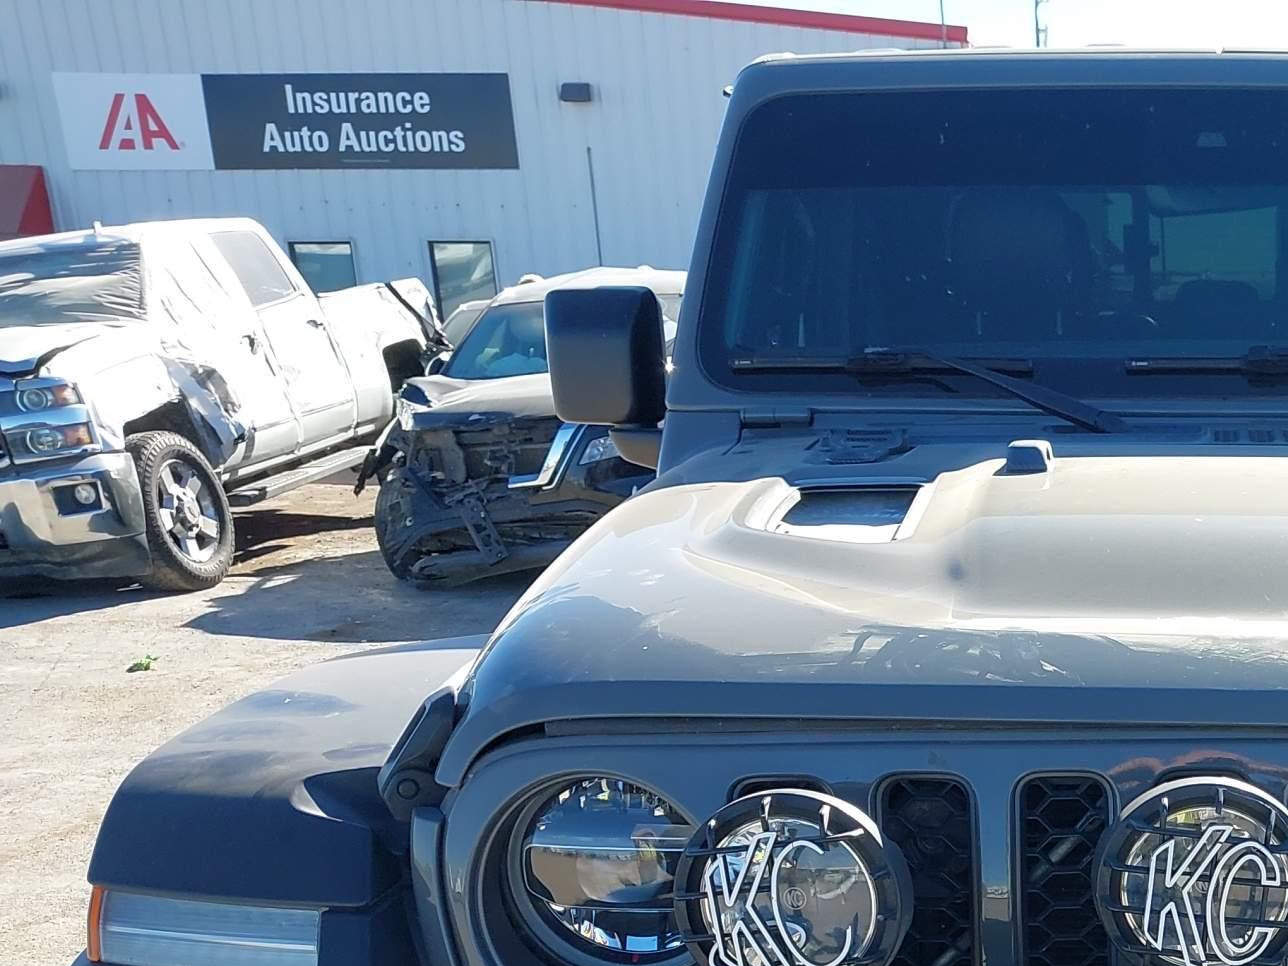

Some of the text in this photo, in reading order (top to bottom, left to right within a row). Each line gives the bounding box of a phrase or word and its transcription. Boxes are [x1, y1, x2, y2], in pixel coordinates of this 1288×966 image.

[284, 84, 431, 113] Insurance
[263, 123, 465, 152] Auto Auctions
